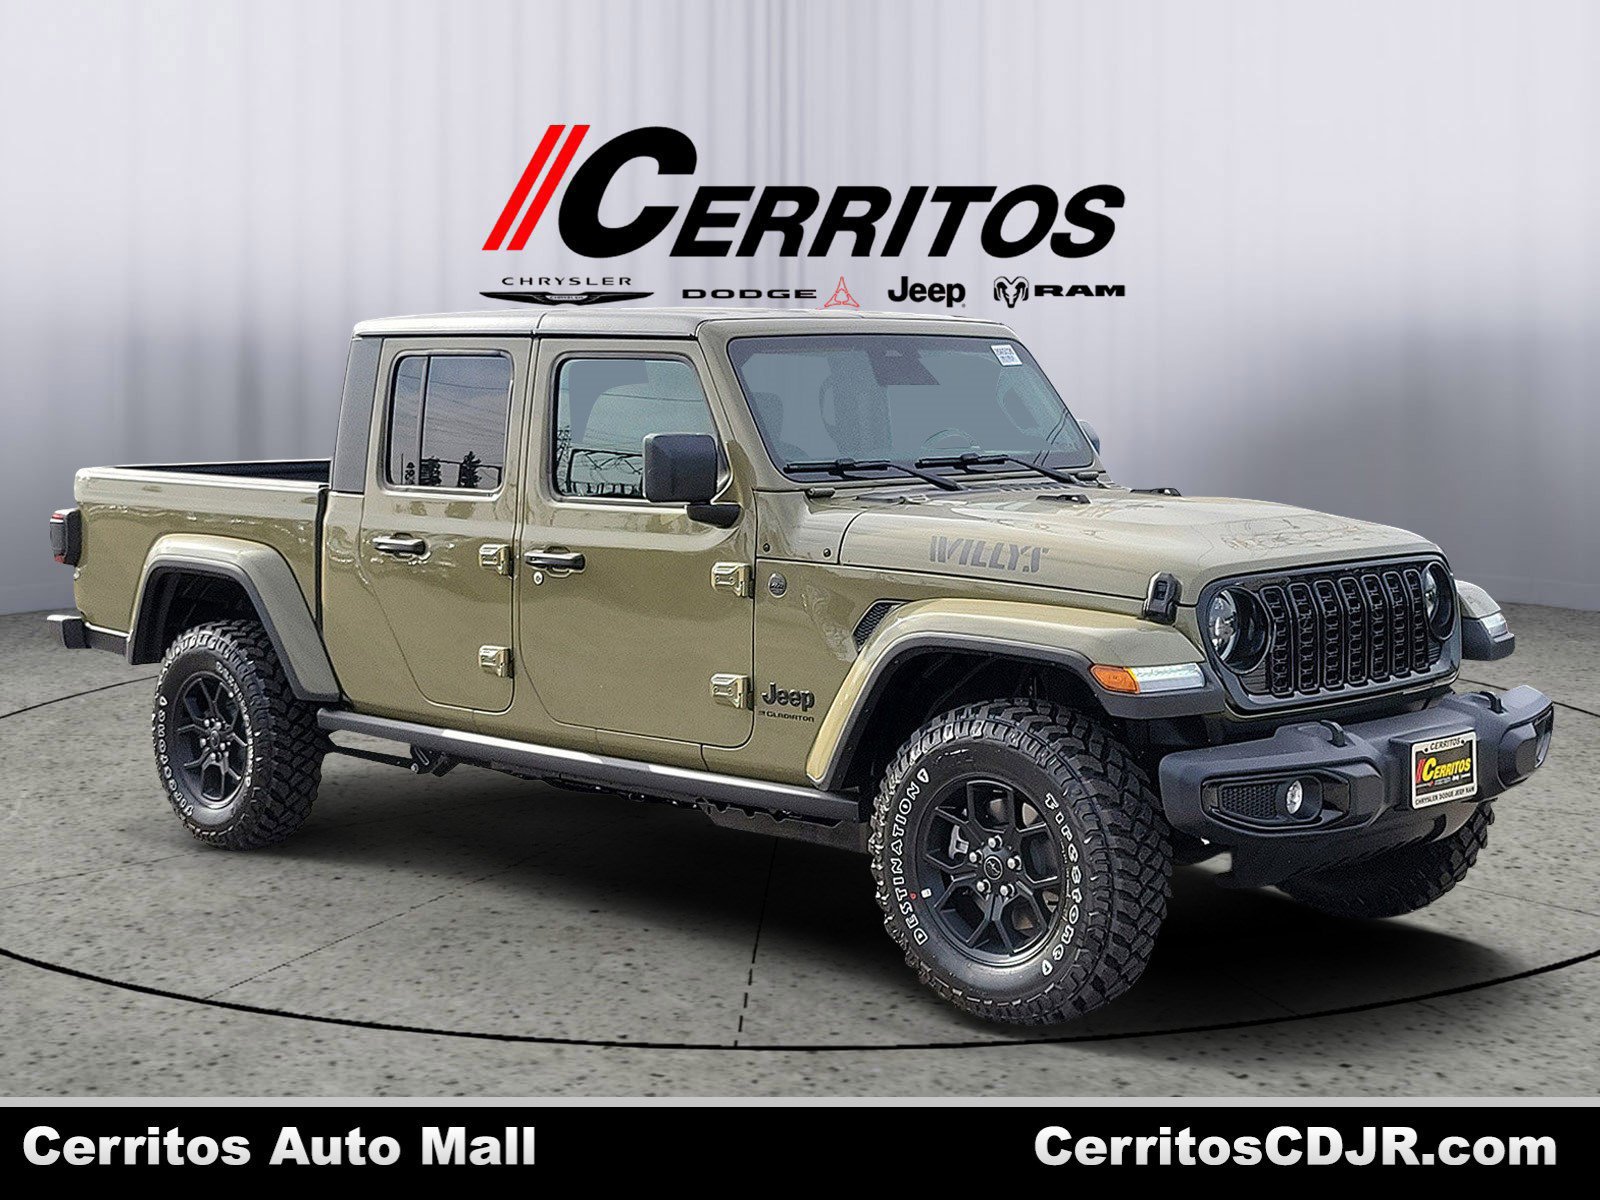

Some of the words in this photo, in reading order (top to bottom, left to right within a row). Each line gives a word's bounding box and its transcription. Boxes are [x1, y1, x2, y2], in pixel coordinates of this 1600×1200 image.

[929, 535, 1050, 573] WILLYS
[762, 682, 815, 712] Jeep
[766, 710, 815, 723] GLADIATOR
[1430, 738, 1461, 750] CERRITOS
[1422, 757, 1471, 782] CERRITOS
[890, 781, 928, 945] DESTINATION
